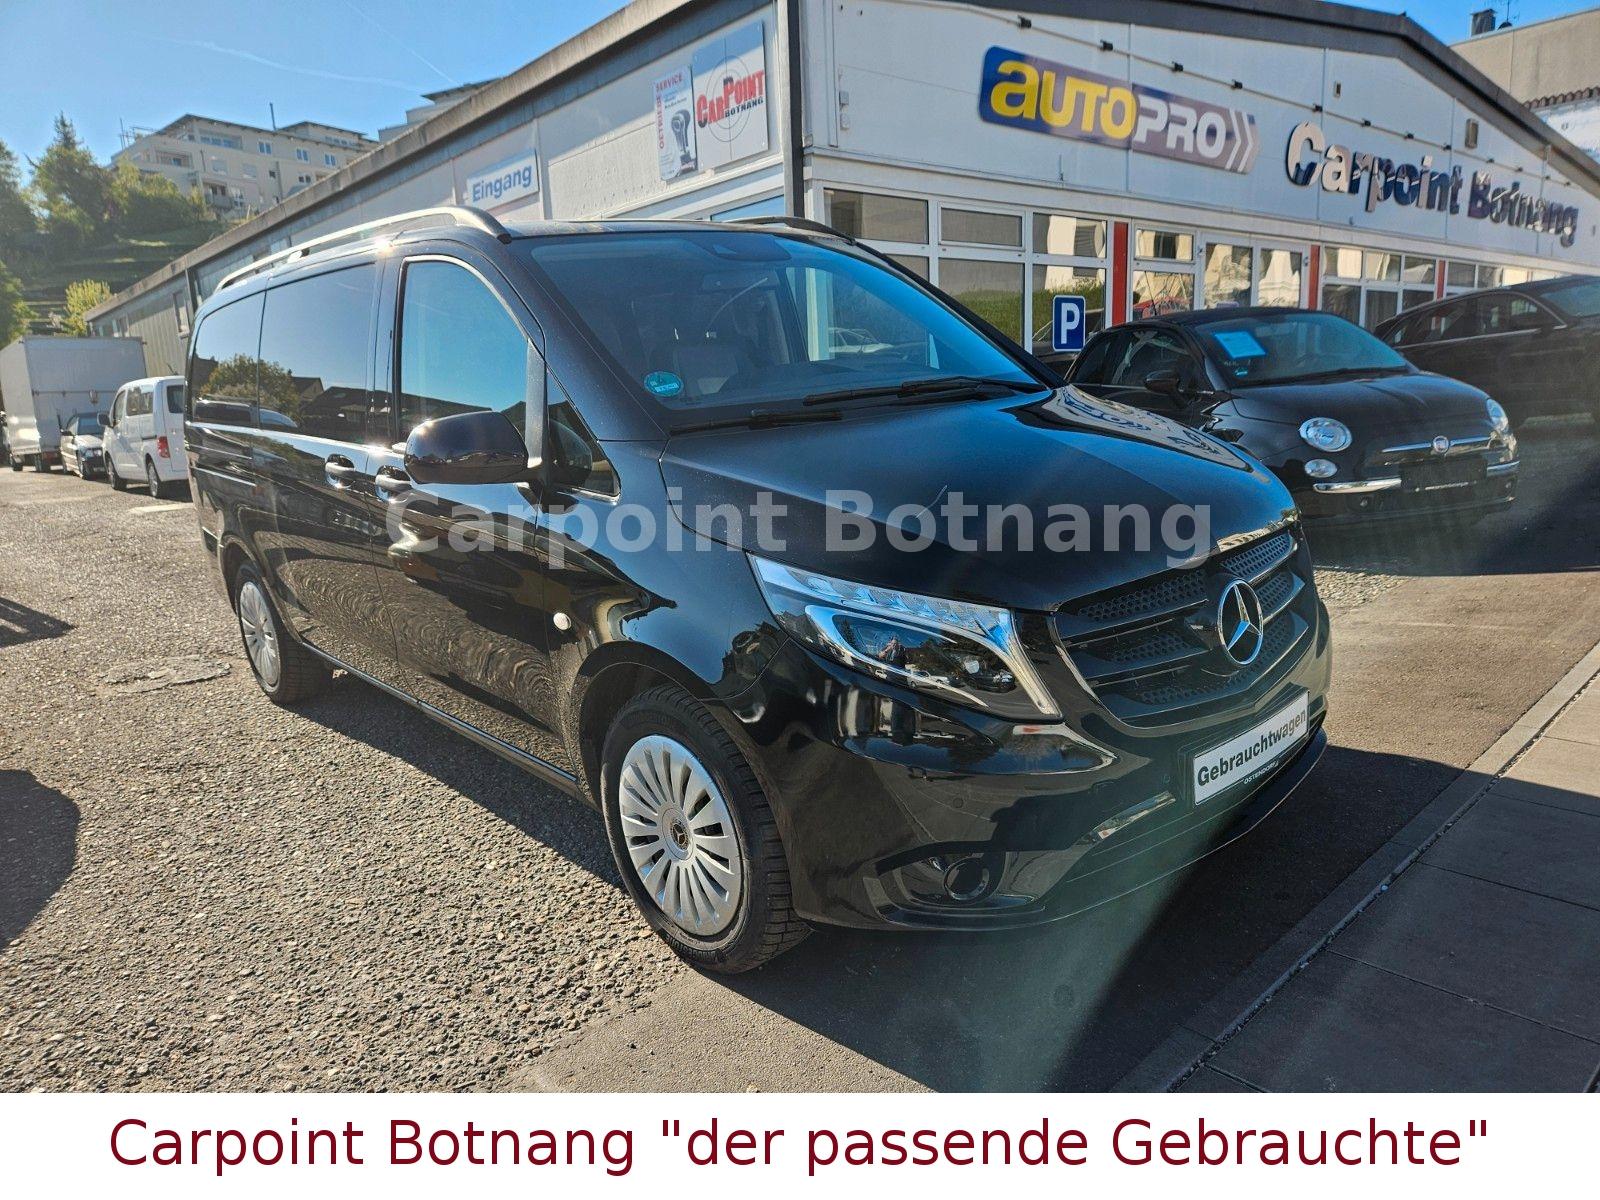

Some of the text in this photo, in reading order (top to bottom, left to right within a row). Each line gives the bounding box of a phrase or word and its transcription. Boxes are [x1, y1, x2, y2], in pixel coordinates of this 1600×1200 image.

[725, 97, 764, 118] BOTNANG
[472, 165, 532, 203] Eingang
[1287, 120, 1579, 248] Carpoint Botnang
[1060, 302, 1080, 345] P
[1197, 708, 1306, 787] Gebrauchtwagen
